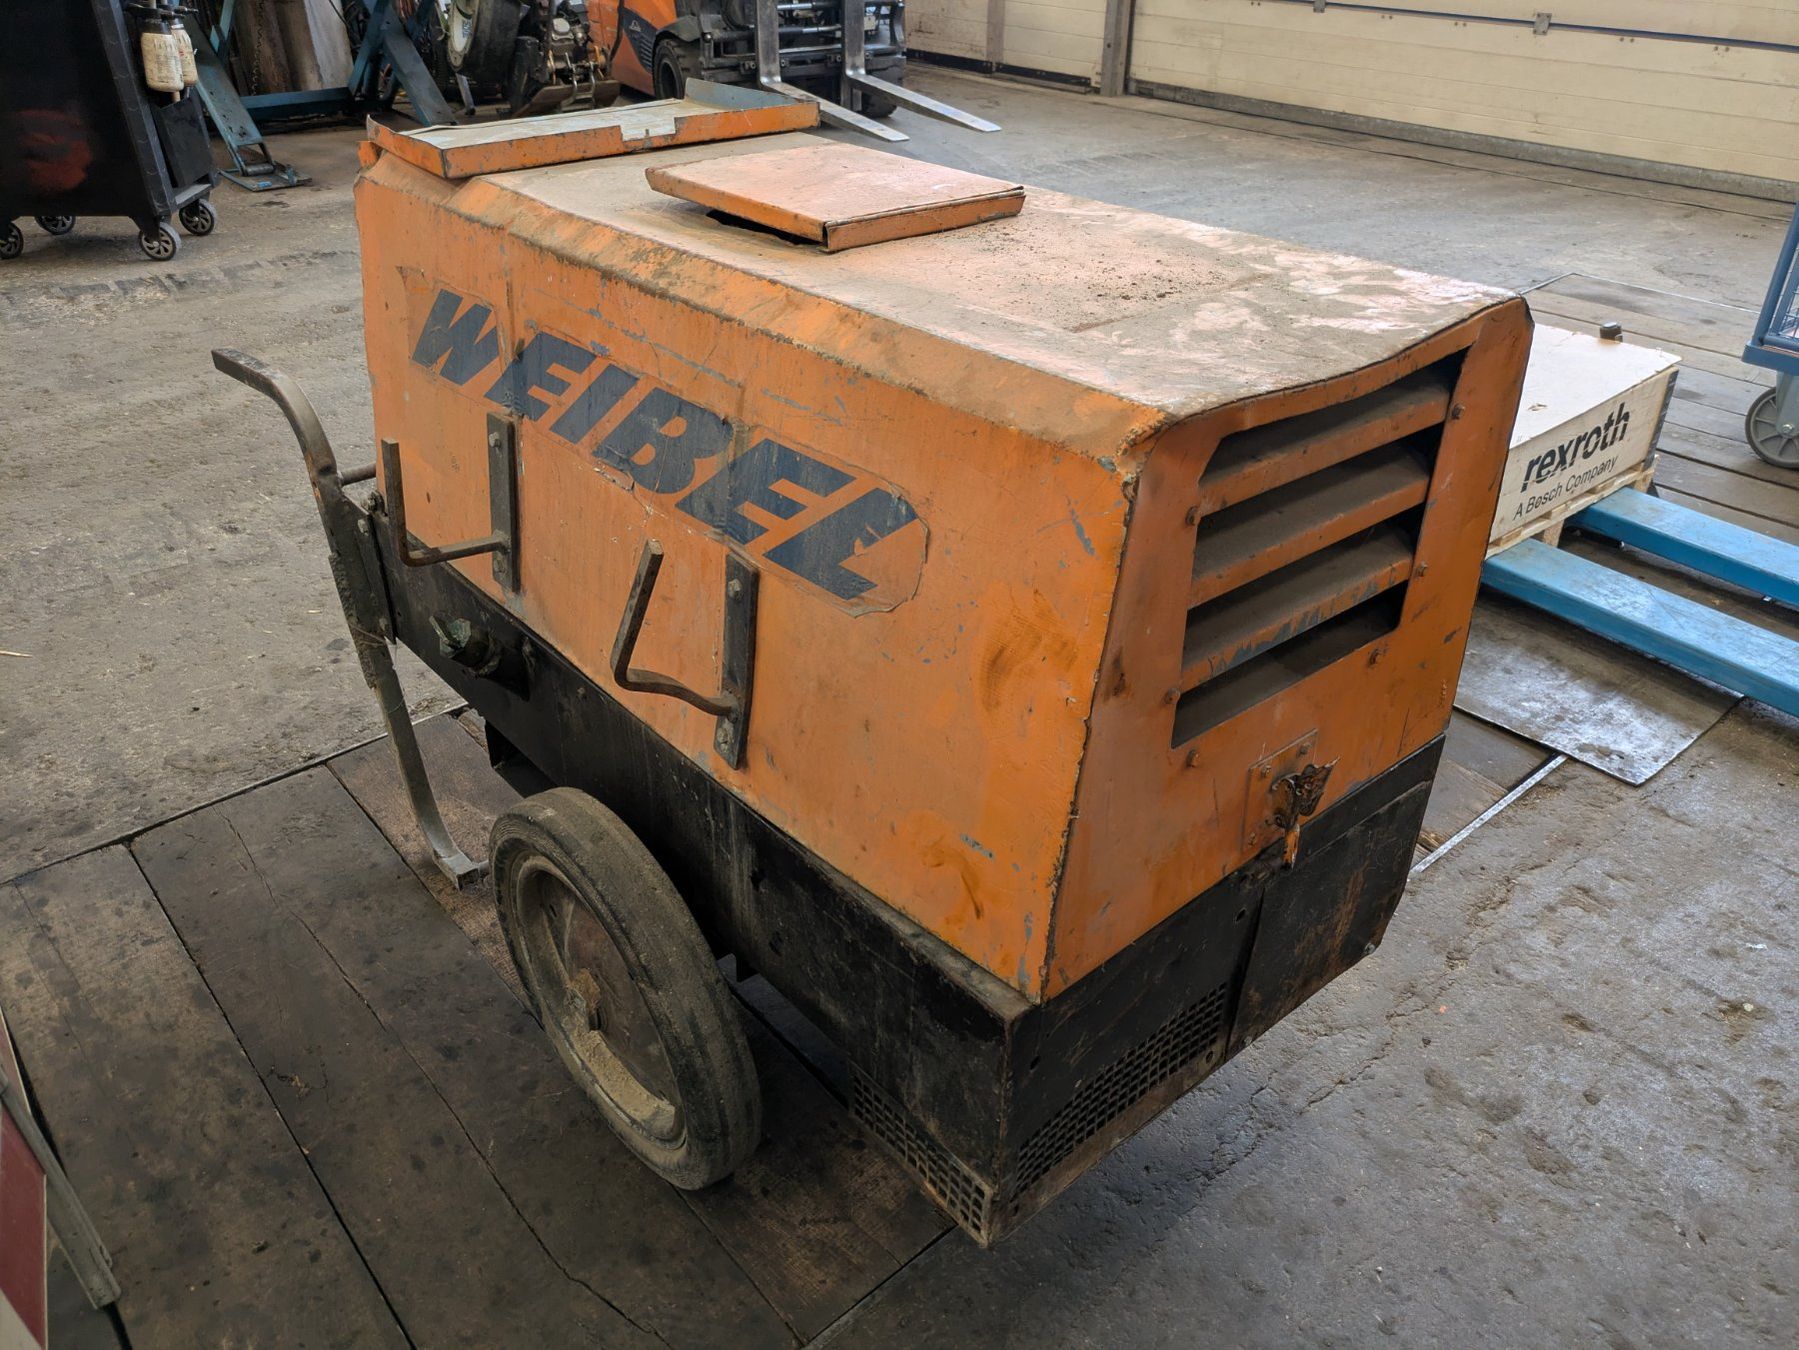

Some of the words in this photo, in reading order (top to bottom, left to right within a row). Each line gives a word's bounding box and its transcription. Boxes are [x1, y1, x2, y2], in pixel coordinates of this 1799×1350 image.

[410, 289, 918, 601] WEIBEL
[1513, 503, 1523, 520] A
[1526, 484, 1562, 513] Bosch
[1566, 456, 1618, 492] Company
[1521, 402, 1630, 493] rexroth
